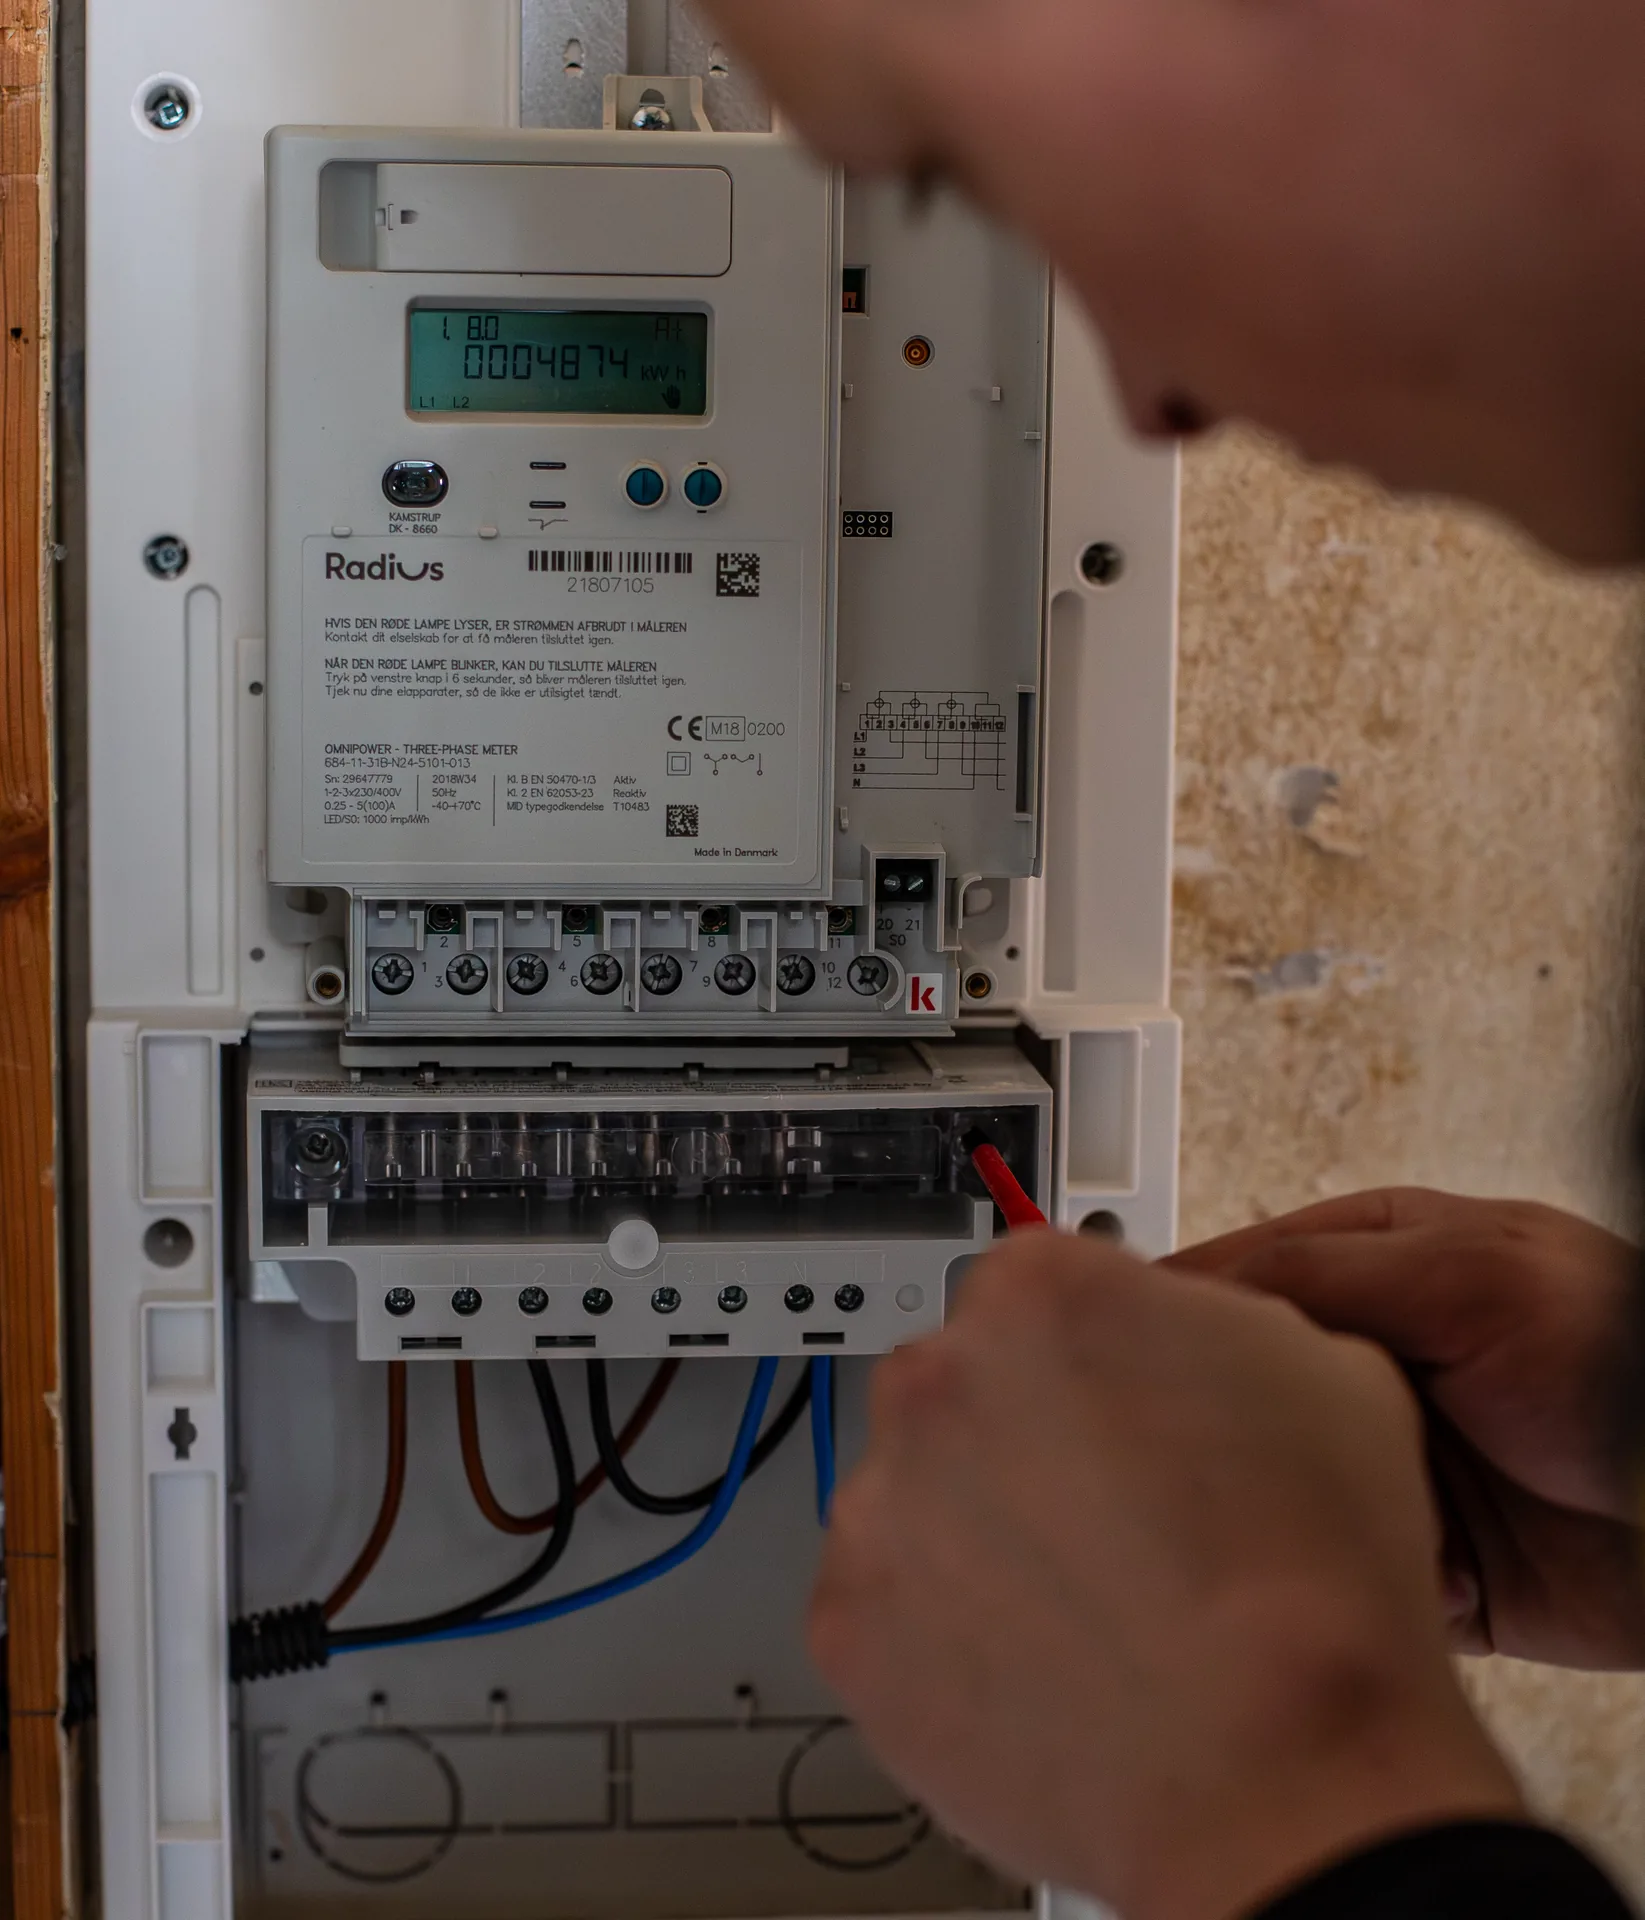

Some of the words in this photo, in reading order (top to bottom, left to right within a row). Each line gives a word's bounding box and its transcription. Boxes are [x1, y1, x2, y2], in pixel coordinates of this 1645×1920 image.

[464, 345, 629, 380] 0004874
[419, 396, 435, 408] L1
[452, 396, 470, 409] L2
[388, 512, 442, 523] KAMSTRUP
[388, 524, 403, 534] DK
[412, 524, 438, 535] 8660
[325, 552, 445, 582] Radius
[567, 577, 655, 594] 21807105
[324, 617, 351, 629] HVIS
[355, 618, 377, 629] DEN
[381, 618, 411, 630] RØDE
[414, 618, 450, 630] LAMPE
[454, 619, 492, 632] LYSER,
[496, 620, 510, 631] ER
[513, 620, 574, 631] STRØMMEN
[577, 621, 627, 632] AFBRUDT
[637, 620, 687, 633] MÅLEREN
[325, 631, 368, 643] Kontakt
[372, 631, 385, 643] dit
[389, 631, 440, 644] elselskab
[443, 632, 460, 644] for
[462, 633, 475, 644] at
[478, 632, 490, 644] få
[494, 633, 538, 645] måleren
[541, 634, 585, 645] tilsluttet
[588, 635, 614, 648] igen.
[324, 656, 348, 670] NÅR
[352, 658, 375, 670] DEN
[378, 658, 407, 670] RØDE
[411, 658, 447, 671] LAMPE
[502, 660, 525, 671] KAN
[529, 660, 544, 672] DU
[548, 660, 603, 672] TILSLUTTE
[607, 659, 657, 672] MÅLEREN
[326, 671, 350, 685] Tryk
[353, 672, 367, 684] på
[370, 672, 412, 684] venstre
[415, 672, 442, 686] knap
[452, 672, 460, 684] 6
[519, 673, 532, 685] så
[536, 673, 565, 685] bliver
[568, 674, 611, 686] måleren
[615, 674, 657, 686] tilsluttet
[325, 684, 350, 699] Tjek
[353, 686, 367, 697] nu
[370, 685, 393, 697] dine
[396, 686, 463, 700] elapparater,
[465, 685, 479, 698] så
[483, 686, 497, 698] de
[500, 686, 520, 698] ikke
[524, 688, 536, 698] er
[539, 687, 585, 701] utilsigtet
[710, 721, 740, 737] M18
[747, 722, 785, 736] 0200
[853, 731, 865, 741] L1
[324, 743, 392, 755] OMNIPOWER
[403, 744, 478, 755] THREE-PHASE
[482, 744, 519, 756] METER
[853, 747, 866, 756] L2
[324, 757, 470, 769] 684-11-31B-N24-5101-013
[324, 774, 340, 784] Sn:
[343, 774, 393, 784] 29647779
[432, 774, 477, 784] 2018W34
[521, 775, 528, 784] B
[531, 775, 544, 785] EN
[546, 775, 596, 785] 50470-1/3
[613, 775, 637, 785] Aktiv
[852, 778, 860, 787] N
[324, 787, 402, 798] 1-2-3x230/400V
[432, 788, 457, 797] 50Hz
[521, 788, 528, 798] 2
[531, 788, 544, 798] EN
[546, 788, 594, 798] 62053-23
[613, 788, 647, 798] Reaktiv
[324, 801, 347, 811] 0.25
[357, 800, 396, 812] 5(100)A
[507, 802, 523, 811] MID
[526, 802, 604, 814] typegodkendelse
[613, 802, 650, 812] T10483
[364, 814, 387, 824] 1000
[390, 813, 430, 825] imp/kWh
[694, 847, 720, 857] Made
[723, 848, 731, 857] in
[735, 848, 778, 857] Denmark
[877, 919, 893, 931] 20
[905, 919, 920, 931] 21
[440, 935, 448, 948] 2
[573, 935, 582, 947] 5
[708, 936, 716, 948] 8
[828, 937, 841, 949] 11
[422, 962, 427, 973] 1
[558, 961, 567, 973] 4
[690, 960, 698, 973] 7
[822, 962, 836, 974] 10
[434, 976, 443, 988] 3
[570, 975, 579, 987] 6
[703, 975, 711, 988] 9
[828, 977, 842, 989] 12
[911, 976, 936, 1011] k
